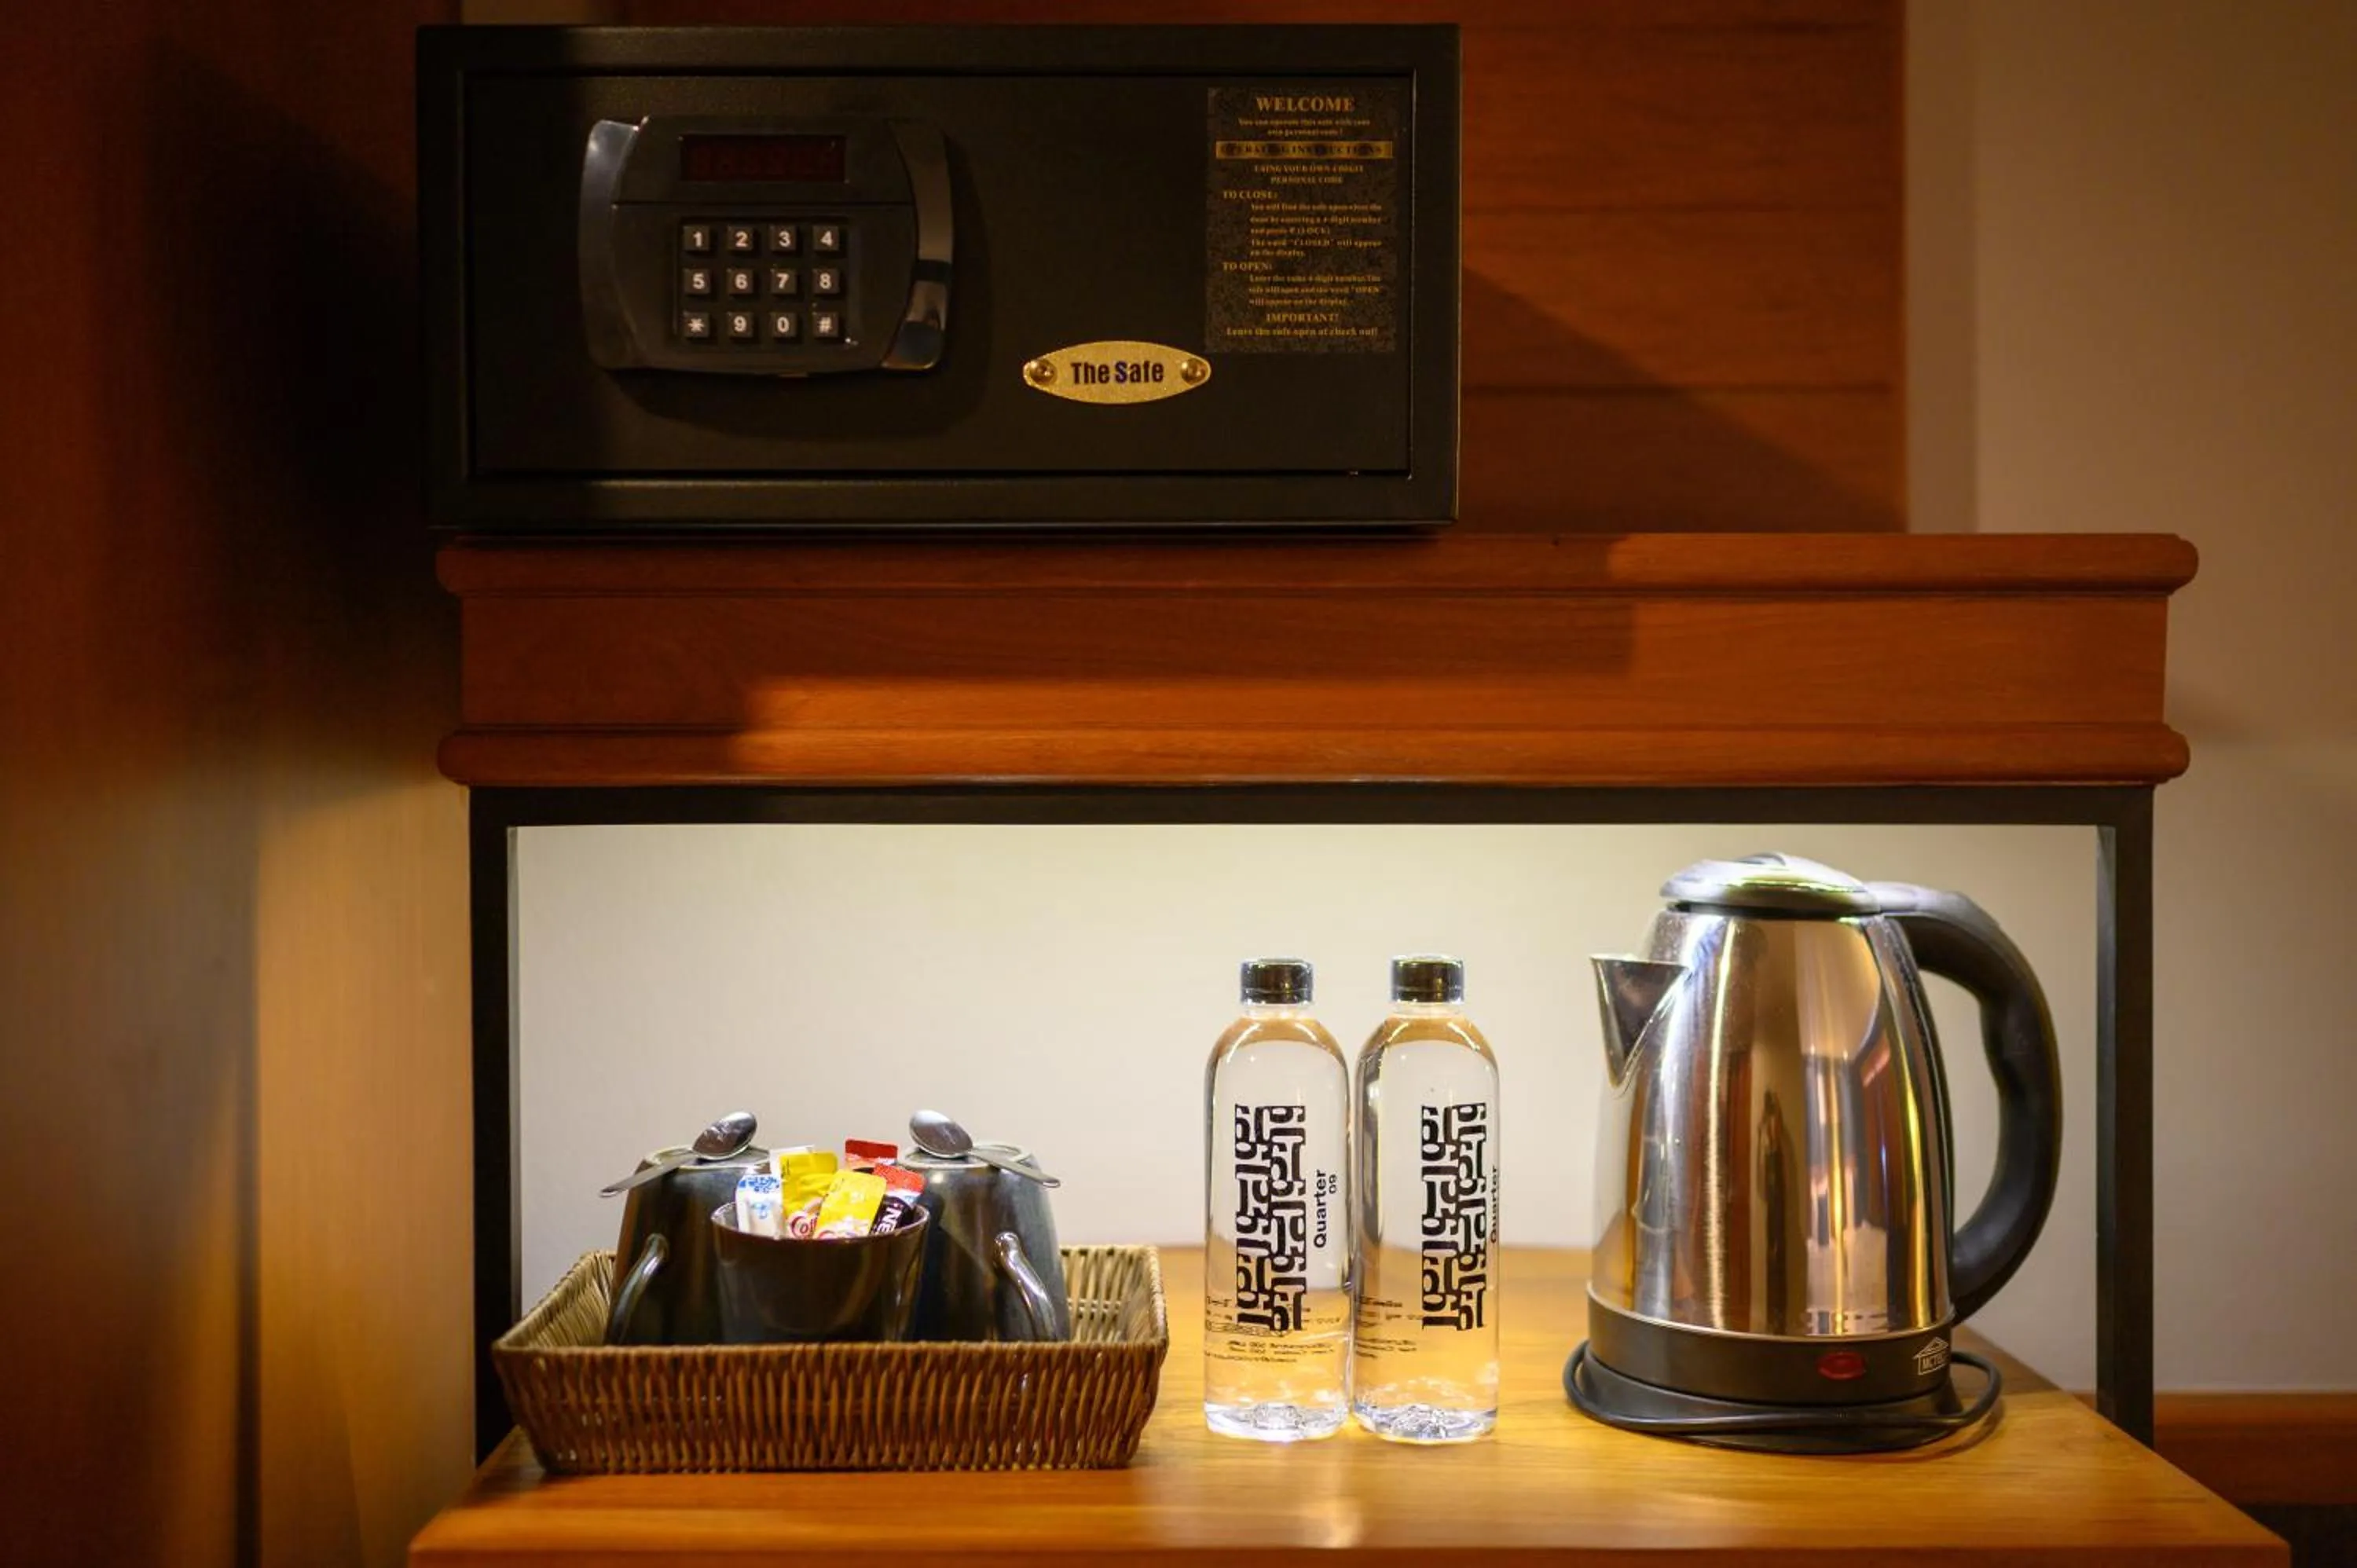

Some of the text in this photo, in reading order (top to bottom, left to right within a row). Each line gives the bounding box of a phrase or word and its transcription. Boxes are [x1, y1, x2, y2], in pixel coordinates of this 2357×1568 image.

[1256, 96, 1356, 112] WELCOME
[1222, 190, 1278, 199] TO CLOSE:
[694, 232, 703, 247] 1
[735, 231, 749, 247] 2
[779, 231, 791, 247] 3
[820, 231, 834, 246] 4
[1222, 262, 1274, 271] TO OPEN:
[692, 273, 706, 290] 5
[735, 273, 748, 290] 6
[777, 273, 789, 288] 7
[819, 273, 831, 289] 8
[734, 316, 747, 332] 9
[777, 316, 790, 333] 0
[1266, 313, 1339, 323] IMPORTANT!
[1071, 361, 1164, 384] The Safe
[1313, 1169, 1328, 1248] Quarter
